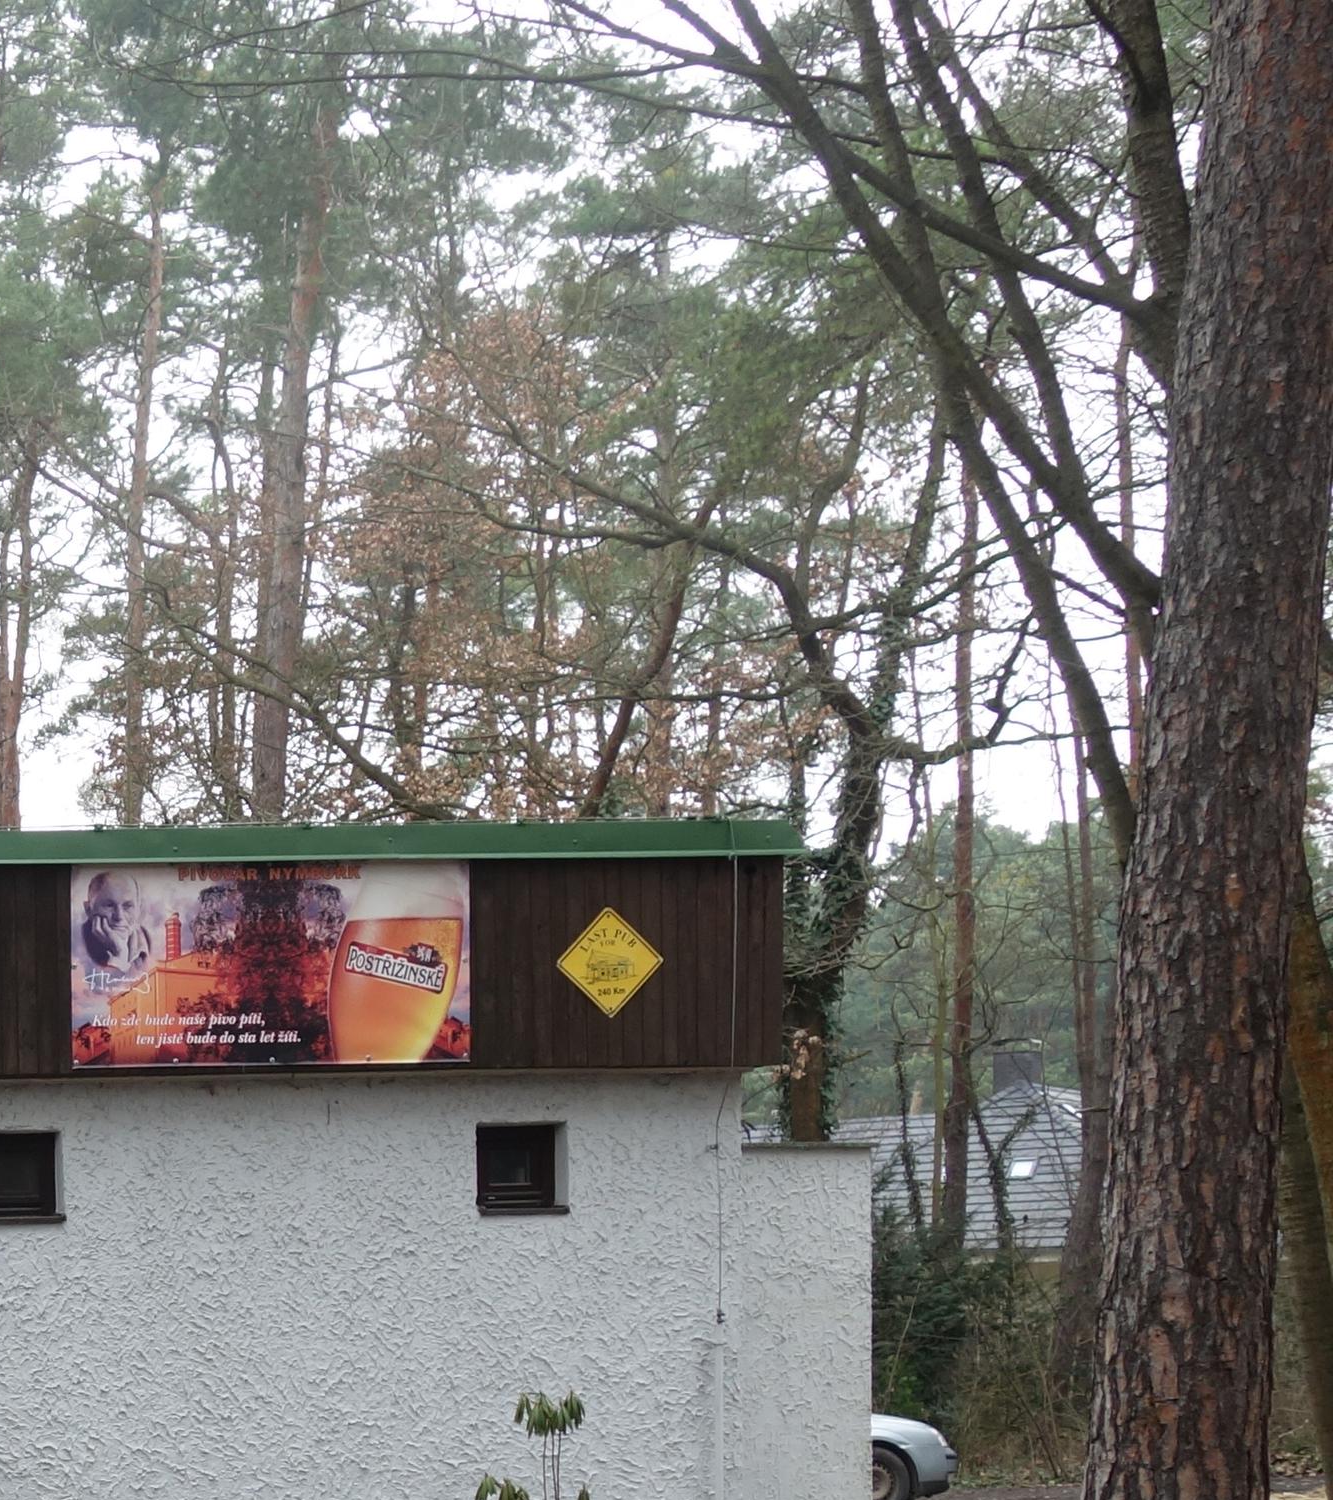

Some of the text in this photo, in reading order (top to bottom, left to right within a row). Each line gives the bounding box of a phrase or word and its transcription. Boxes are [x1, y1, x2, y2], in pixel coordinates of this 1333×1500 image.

[177, 864, 361, 881] PIVOVAR NYMBURK
[579, 928, 637, 952] LAST PUB
[348, 947, 444, 988] POSTŘIŽINSKÉ
[92, 1014, 118, 1027] Kdo
[121, 1014, 141, 1026] zde
[145, 1013, 175, 1026] bude
[178, 1012, 206, 1026] naše
[208, 1012, 237, 1029] pivo
[136, 1034, 155, 1045] ten
[155, 1033, 184, 1048] jistě
[186, 1032, 217, 1044] bude
[219, 1031, 236, 1043] do
[237, 1032, 257, 1043] sta
[259, 1031, 276, 1043] let
